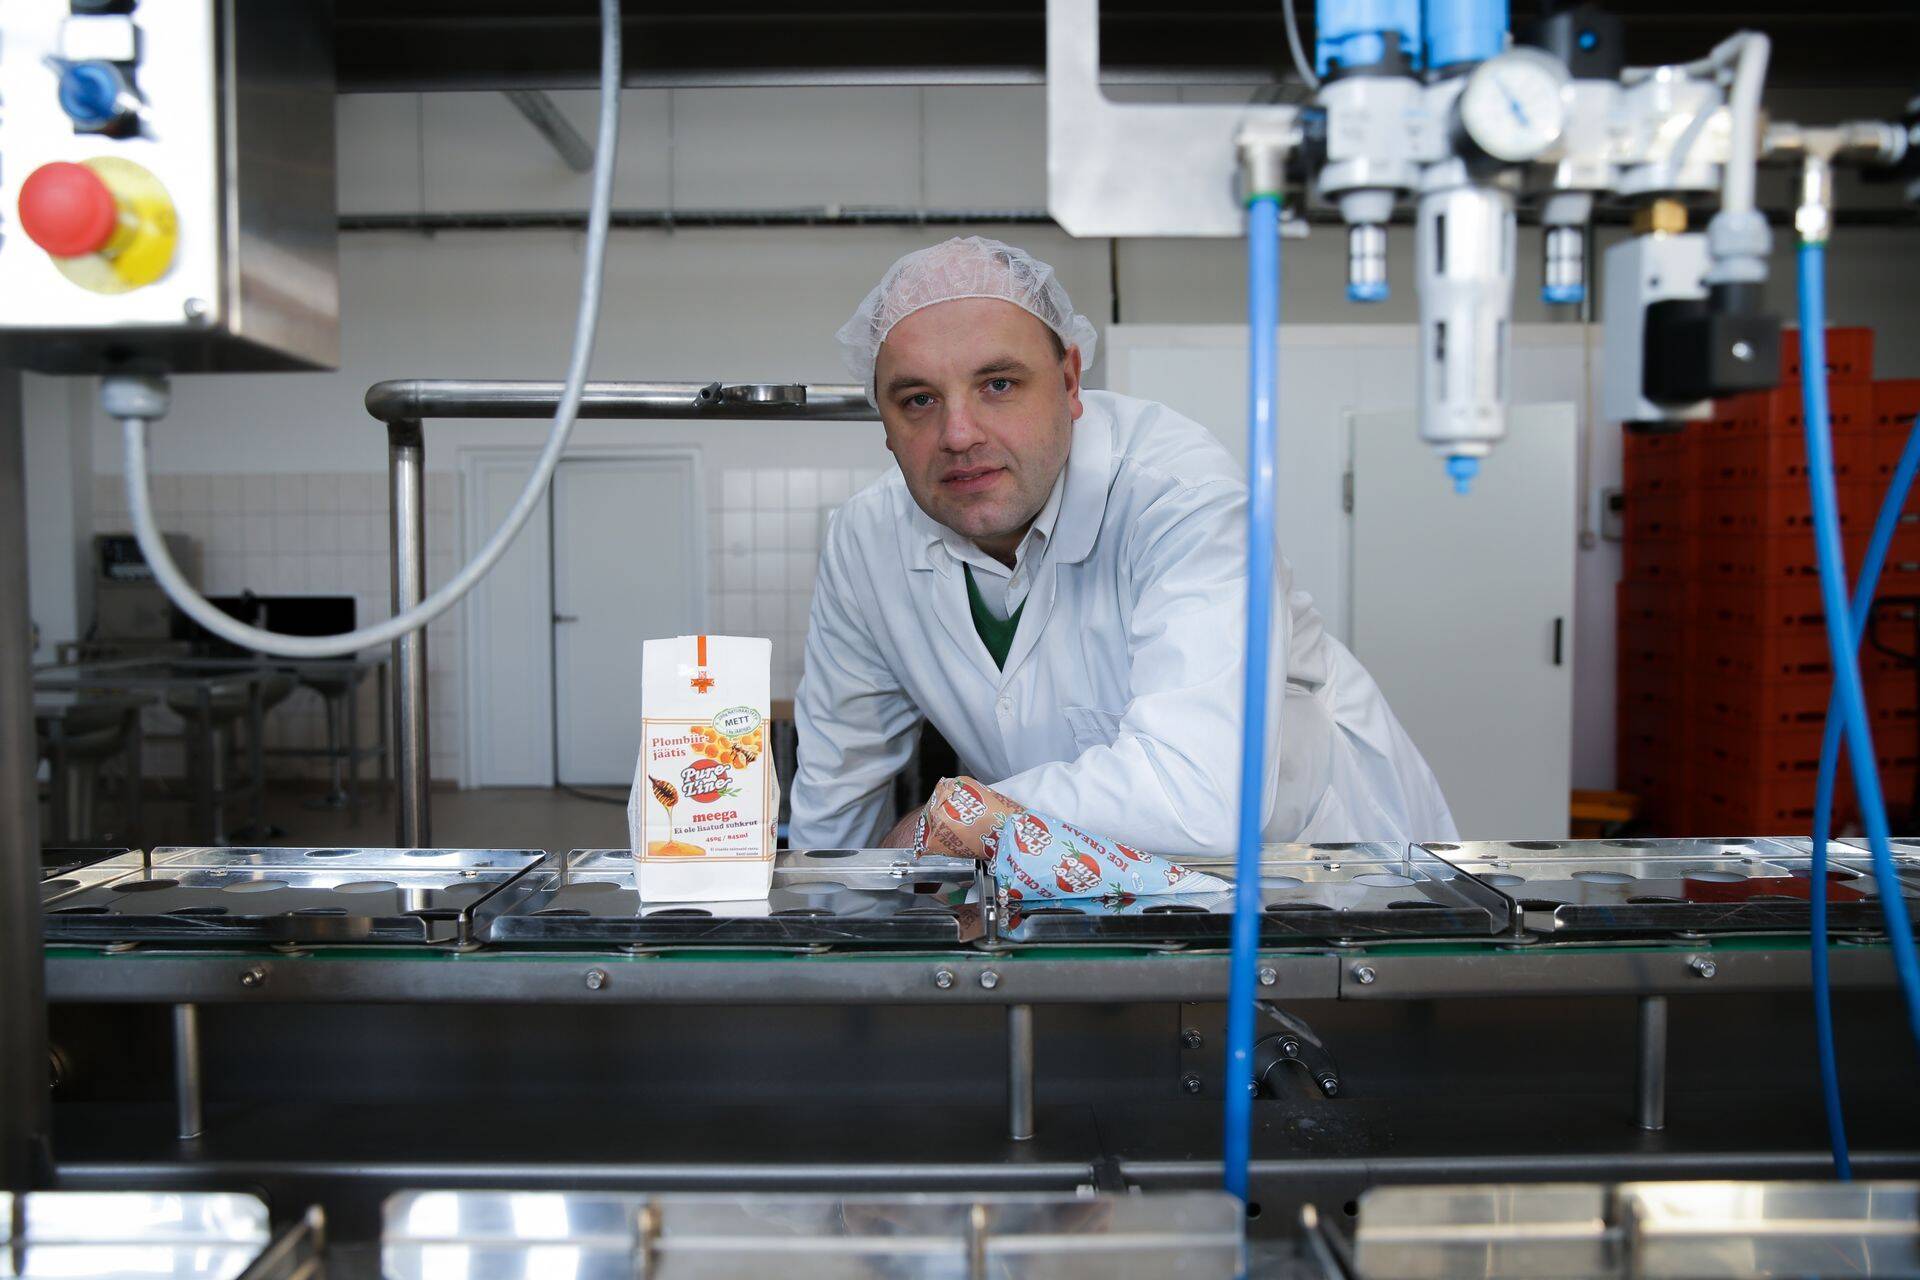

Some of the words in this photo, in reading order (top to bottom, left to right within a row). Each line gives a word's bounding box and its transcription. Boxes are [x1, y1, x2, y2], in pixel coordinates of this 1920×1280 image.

[724, 715, 750, 727] METT
[652, 734, 709, 748] Plombiir-
[653, 748, 687, 761] jäätis
[681, 763, 731, 782] Pure
[682, 777, 733, 798] Line
[692, 809, 738, 823] meega
[674, 827, 682, 835] Ei
[684, 826, 696, 835] ole
[697, 823, 725, 833] lisatud
[725, 819, 759, 830] suhkrut
[1062, 823, 1106, 855] CREAM
[1060, 853, 1102, 887] Line
[1106, 851, 1128, 871] ICE
[1006, 853, 1040, 891] CREAM
[1051, 864, 1092, 895] Pure
